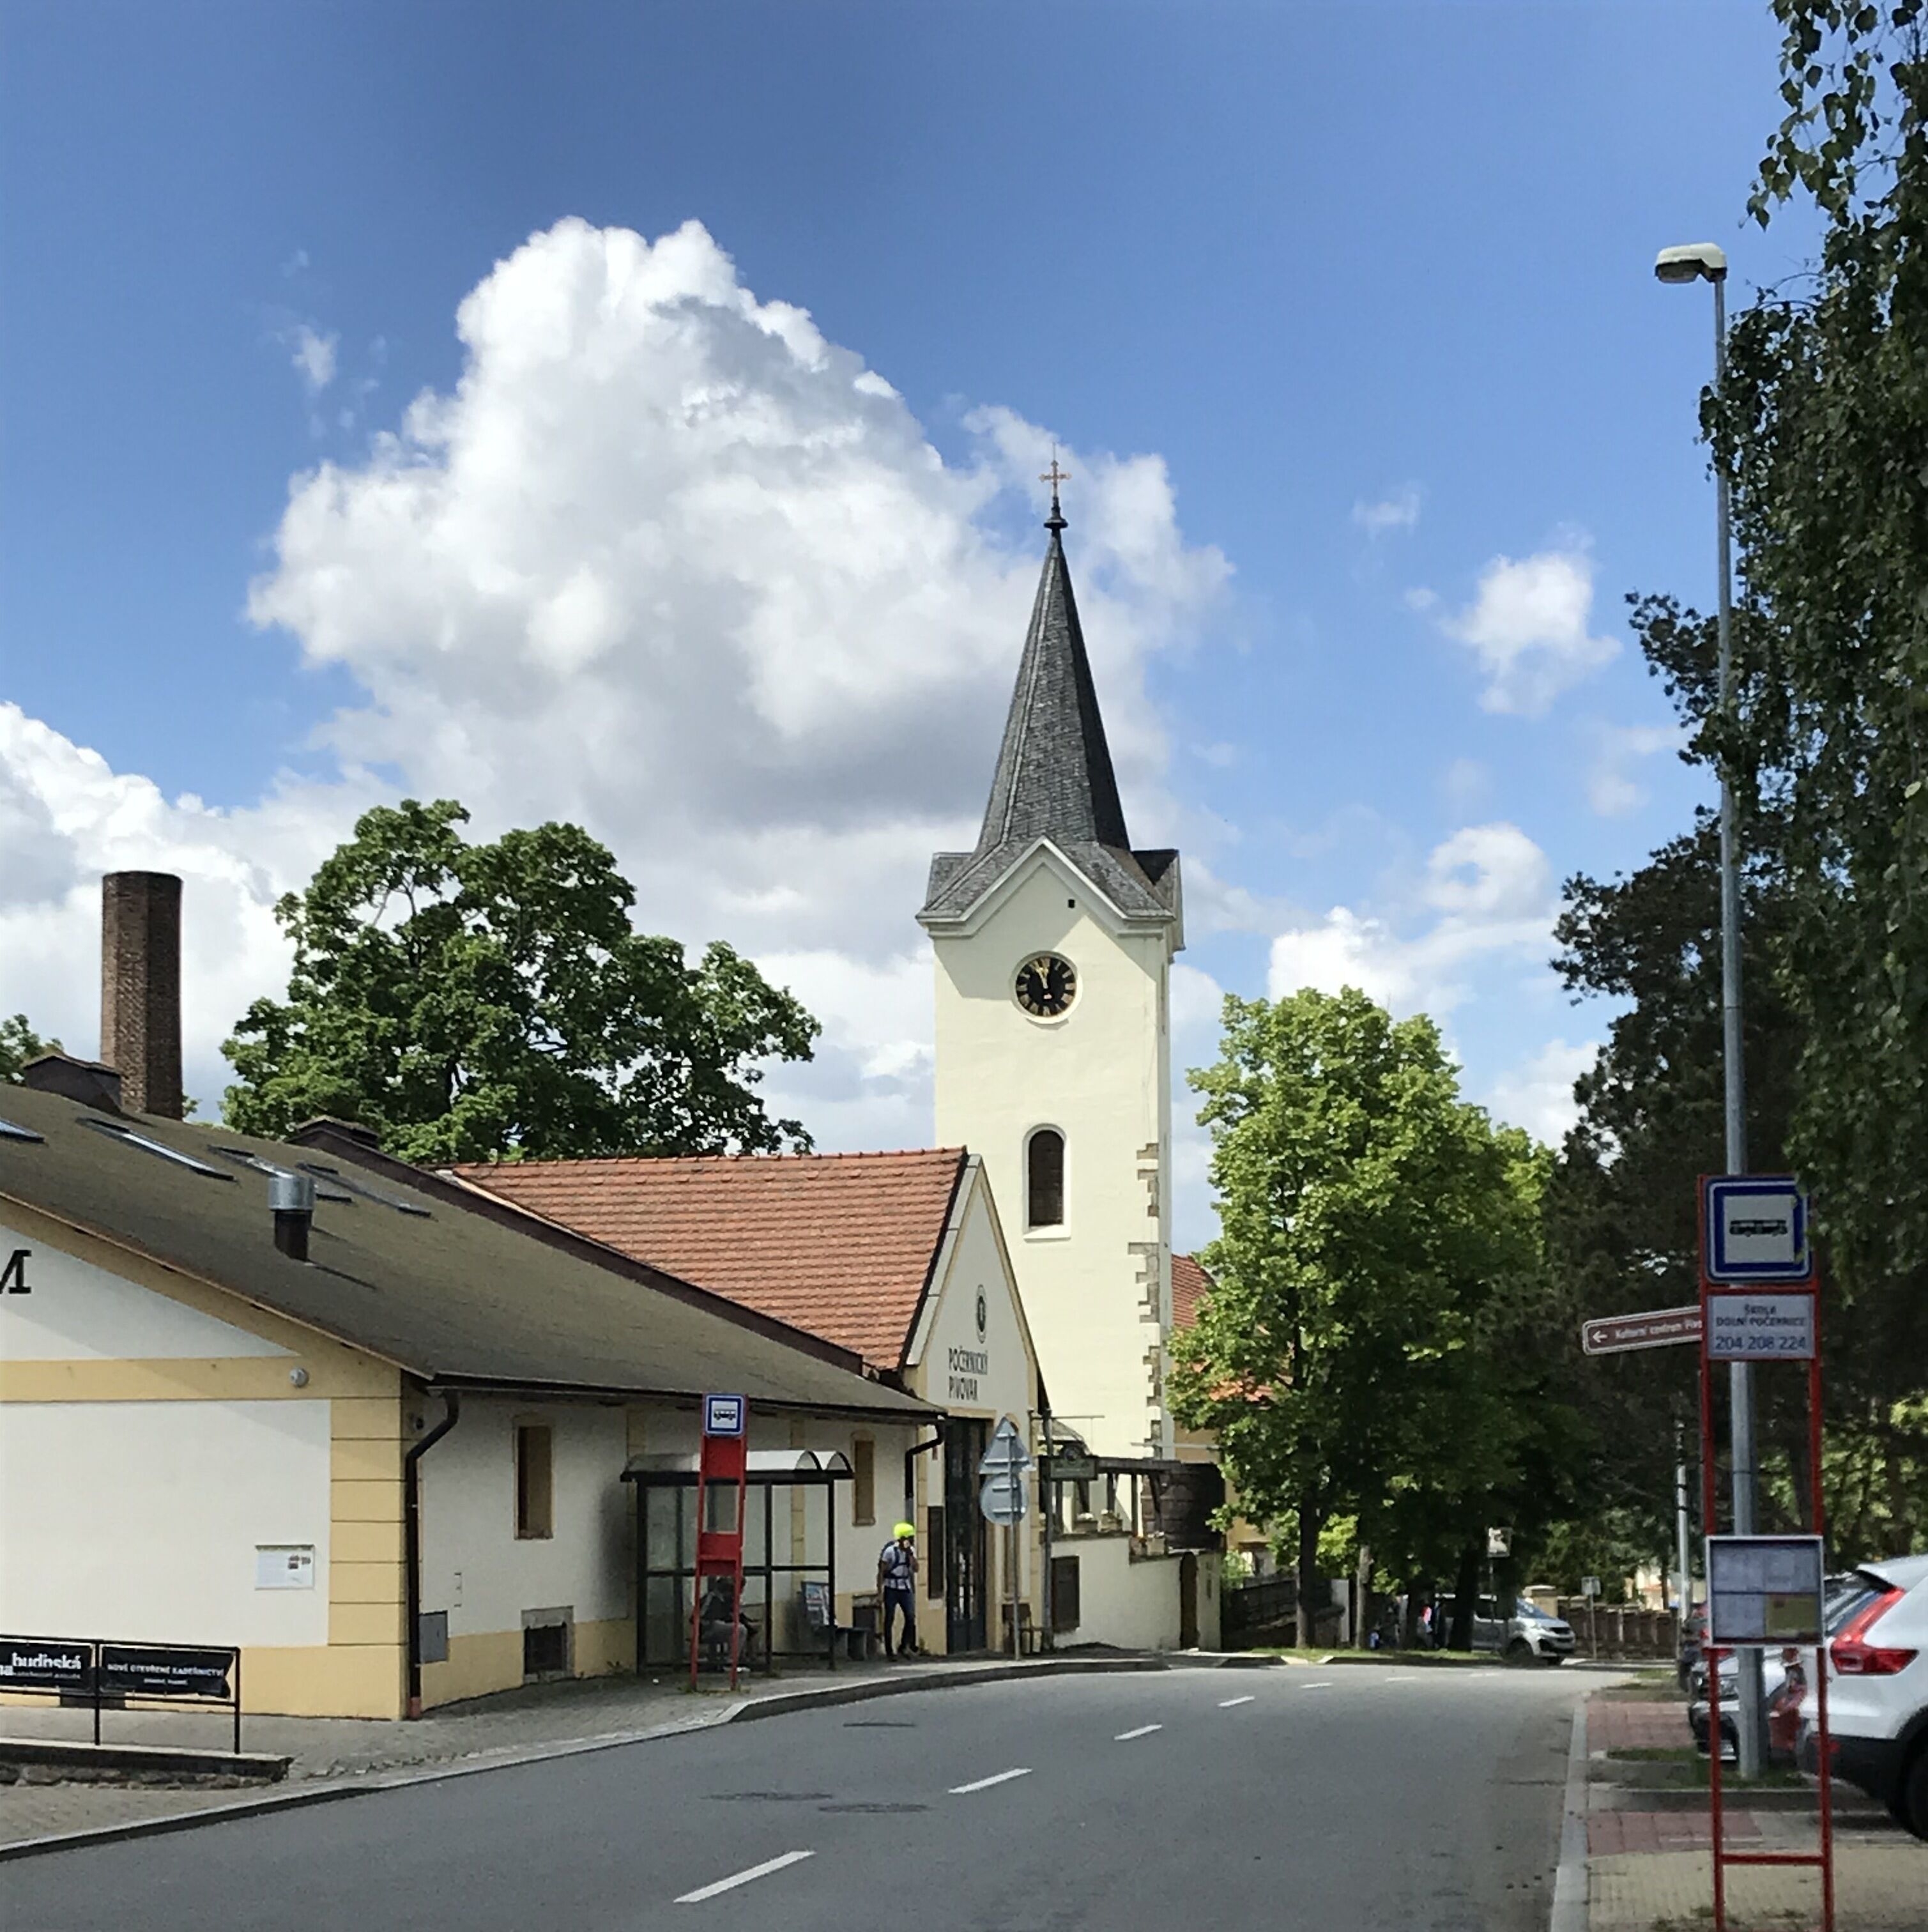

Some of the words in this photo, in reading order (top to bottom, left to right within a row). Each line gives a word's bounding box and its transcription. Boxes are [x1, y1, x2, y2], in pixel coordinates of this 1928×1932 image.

[1715, 1336, 1743, 1350] 204
[1748, 1336, 1775, 1350] 208
[1779, 1336, 1806, 1350] 224
